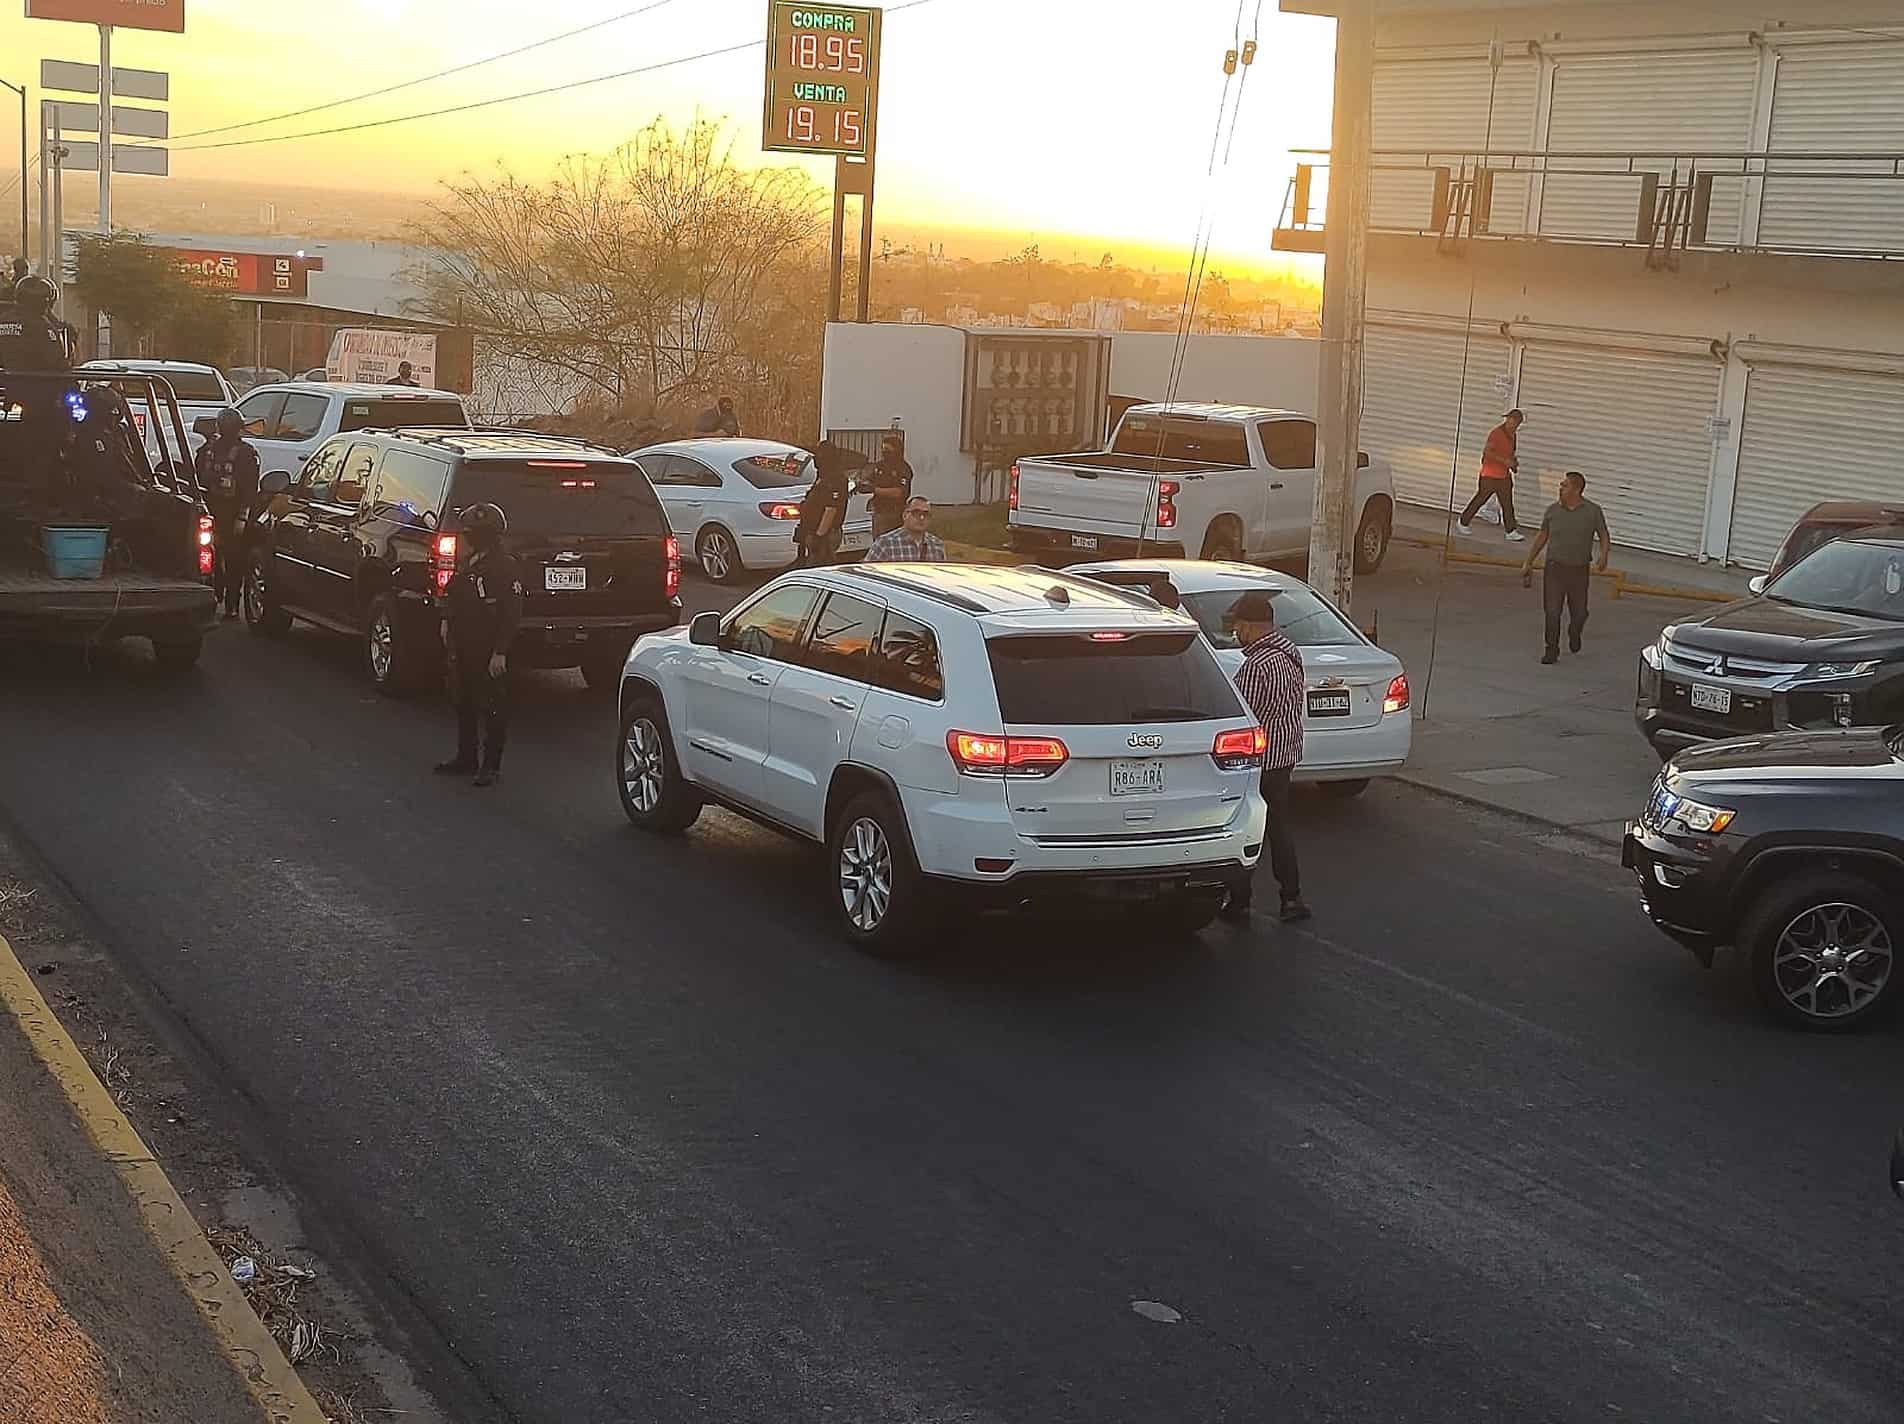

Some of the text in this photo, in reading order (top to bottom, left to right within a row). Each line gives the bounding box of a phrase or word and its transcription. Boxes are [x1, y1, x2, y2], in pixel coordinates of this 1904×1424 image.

[791, 10, 855, 32] COMPRA
[790, 34, 863, 73] 18.95
[793, 83, 846, 102] VENTA
[1127, 733, 1164, 749] Jeep
[1115, 769, 1162, 785] R86-ARA
